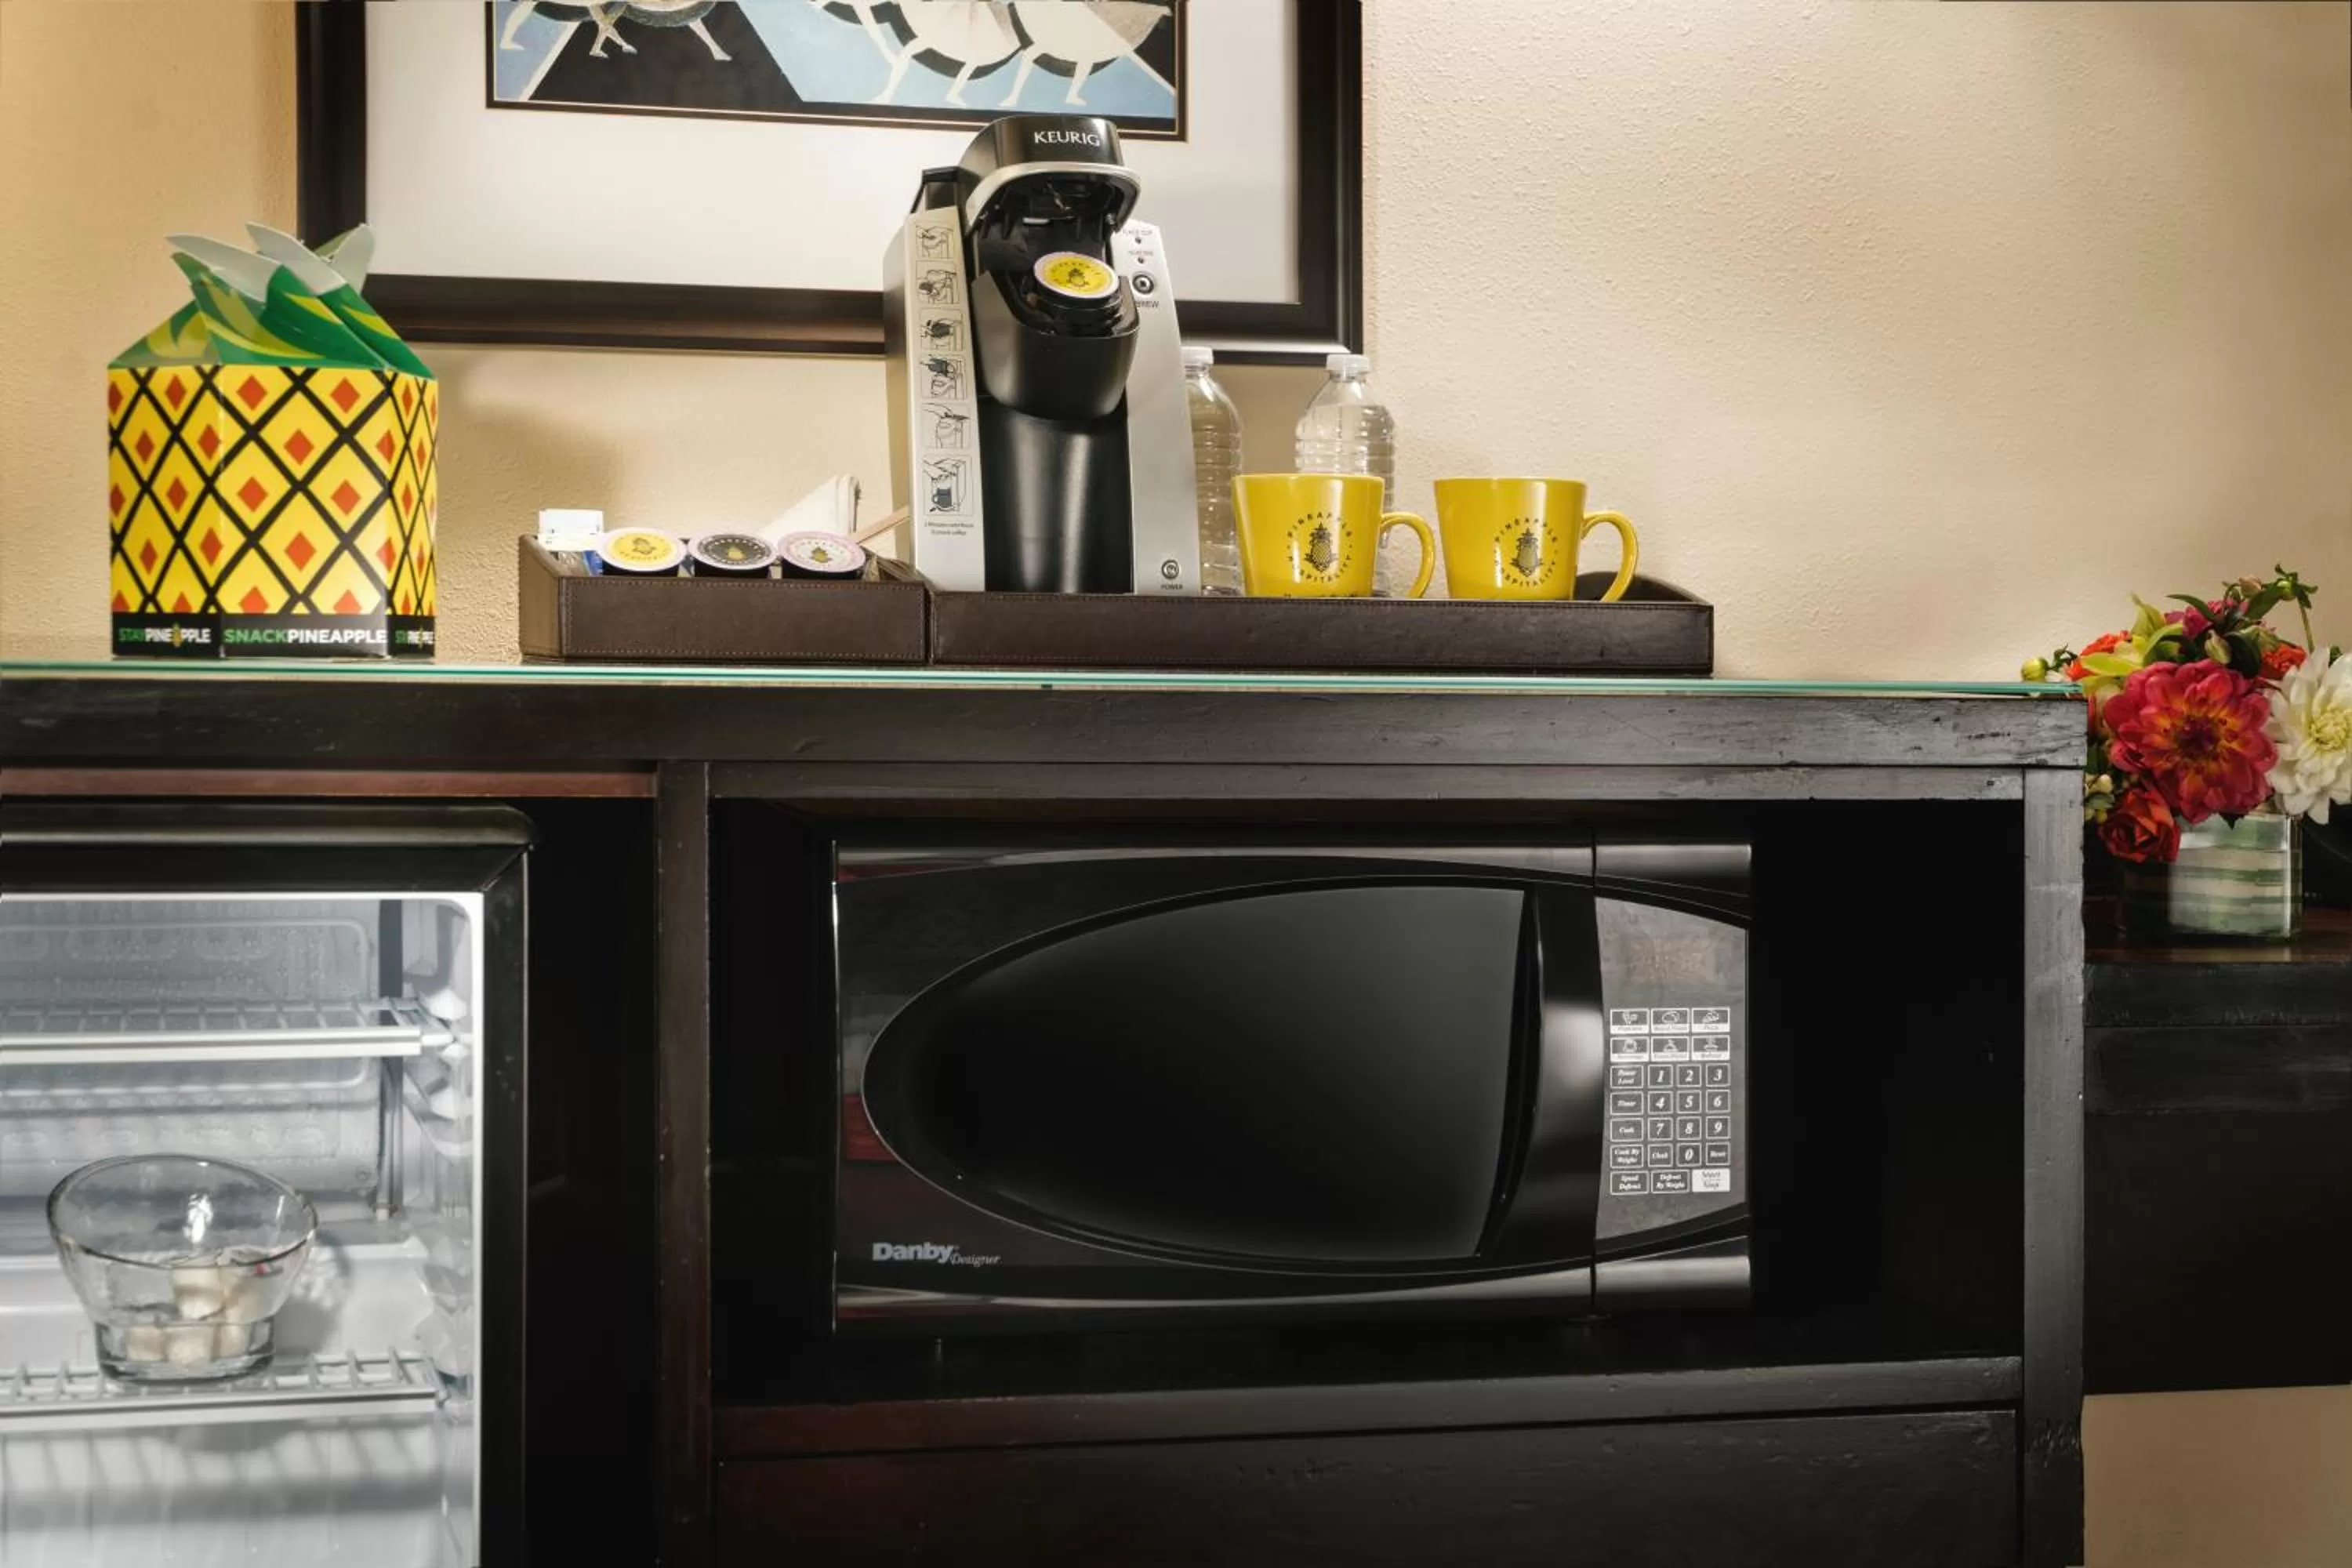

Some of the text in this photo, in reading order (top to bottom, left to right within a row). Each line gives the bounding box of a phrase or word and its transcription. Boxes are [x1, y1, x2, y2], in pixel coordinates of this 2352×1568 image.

[1034, 130, 1101, 146] KEURIG
[1657, 1070, 1664, 1083] 1
[1686, 1069, 1693, 1082] 2
[1714, 1069, 1722, 1081] 3
[1656, 1097, 1664, 1109] 4
[1686, 1096, 1693, 1109] 5
[1714, 1095, 1722, 1107] 6
[1657, 1123, 1664, 1136] 7
[1685, 1122, 1693, 1134] 8
[1715, 1122, 1722, 1133] 9
[1686, 1149, 1693, 1161] 0
[873, 1242, 954, 1264] Danby
